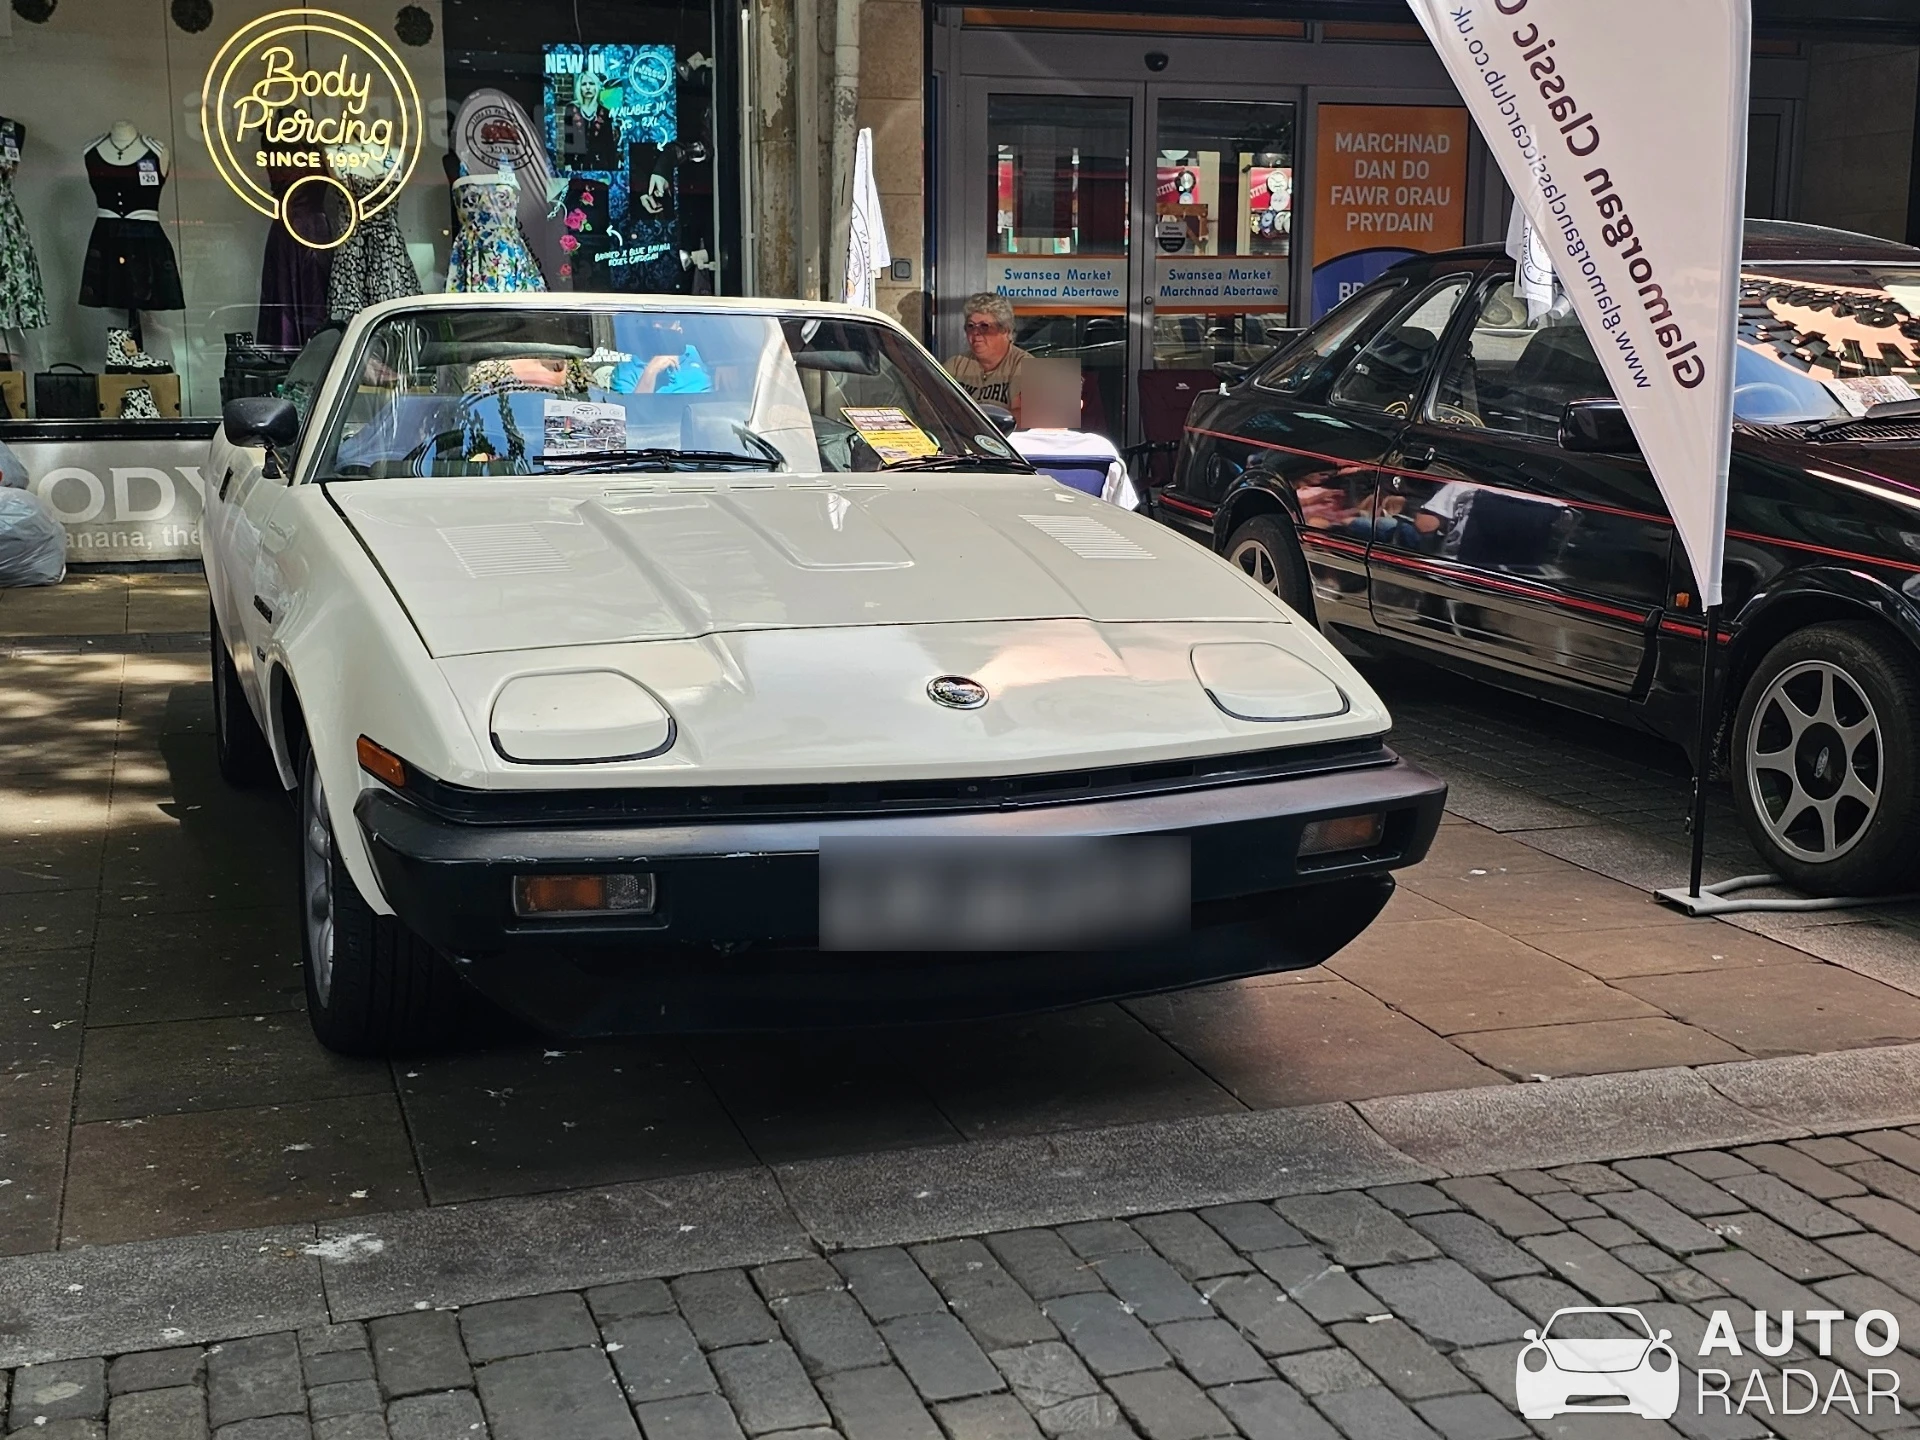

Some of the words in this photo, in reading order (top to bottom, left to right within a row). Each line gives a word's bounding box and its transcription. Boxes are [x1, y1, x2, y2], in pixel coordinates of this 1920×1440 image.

[545, 54, 584, 74] NEW
[588, 53, 605, 74] IN
[253, 46, 371, 114] Body
[608, 102, 652, 118] AVAILABLE
[233, 95, 393, 160] Piercing
[1335, 132, 1451, 154] MARCHNAD
[256, 151, 321, 168] SINCE
[327, 152, 370, 168] 1997
[1354, 159, 1395, 179] DAN
[1402, 160, 1430, 180] DO
[1331, 186, 1389, 205] FAWR
[1395, 186, 1451, 206] ORAU
[1346, 212, 1434, 232] PRYDAIN
[1004, 268, 1060, 280] Swansea
[1066, 268, 1112, 280] Market
[1168, 268, 1222, 280] Swansea
[1228, 268, 1272, 280] Market
[996, 285, 1057, 297] Marchnad
[1062, 285, 1120, 297] Abertawe
[1159, 284, 1219, 297] Marchnad
[1223, 284, 1279, 297] Abertawe
[977, 382, 1009, 404] YORK
[65, 531, 153, 550] anana,
